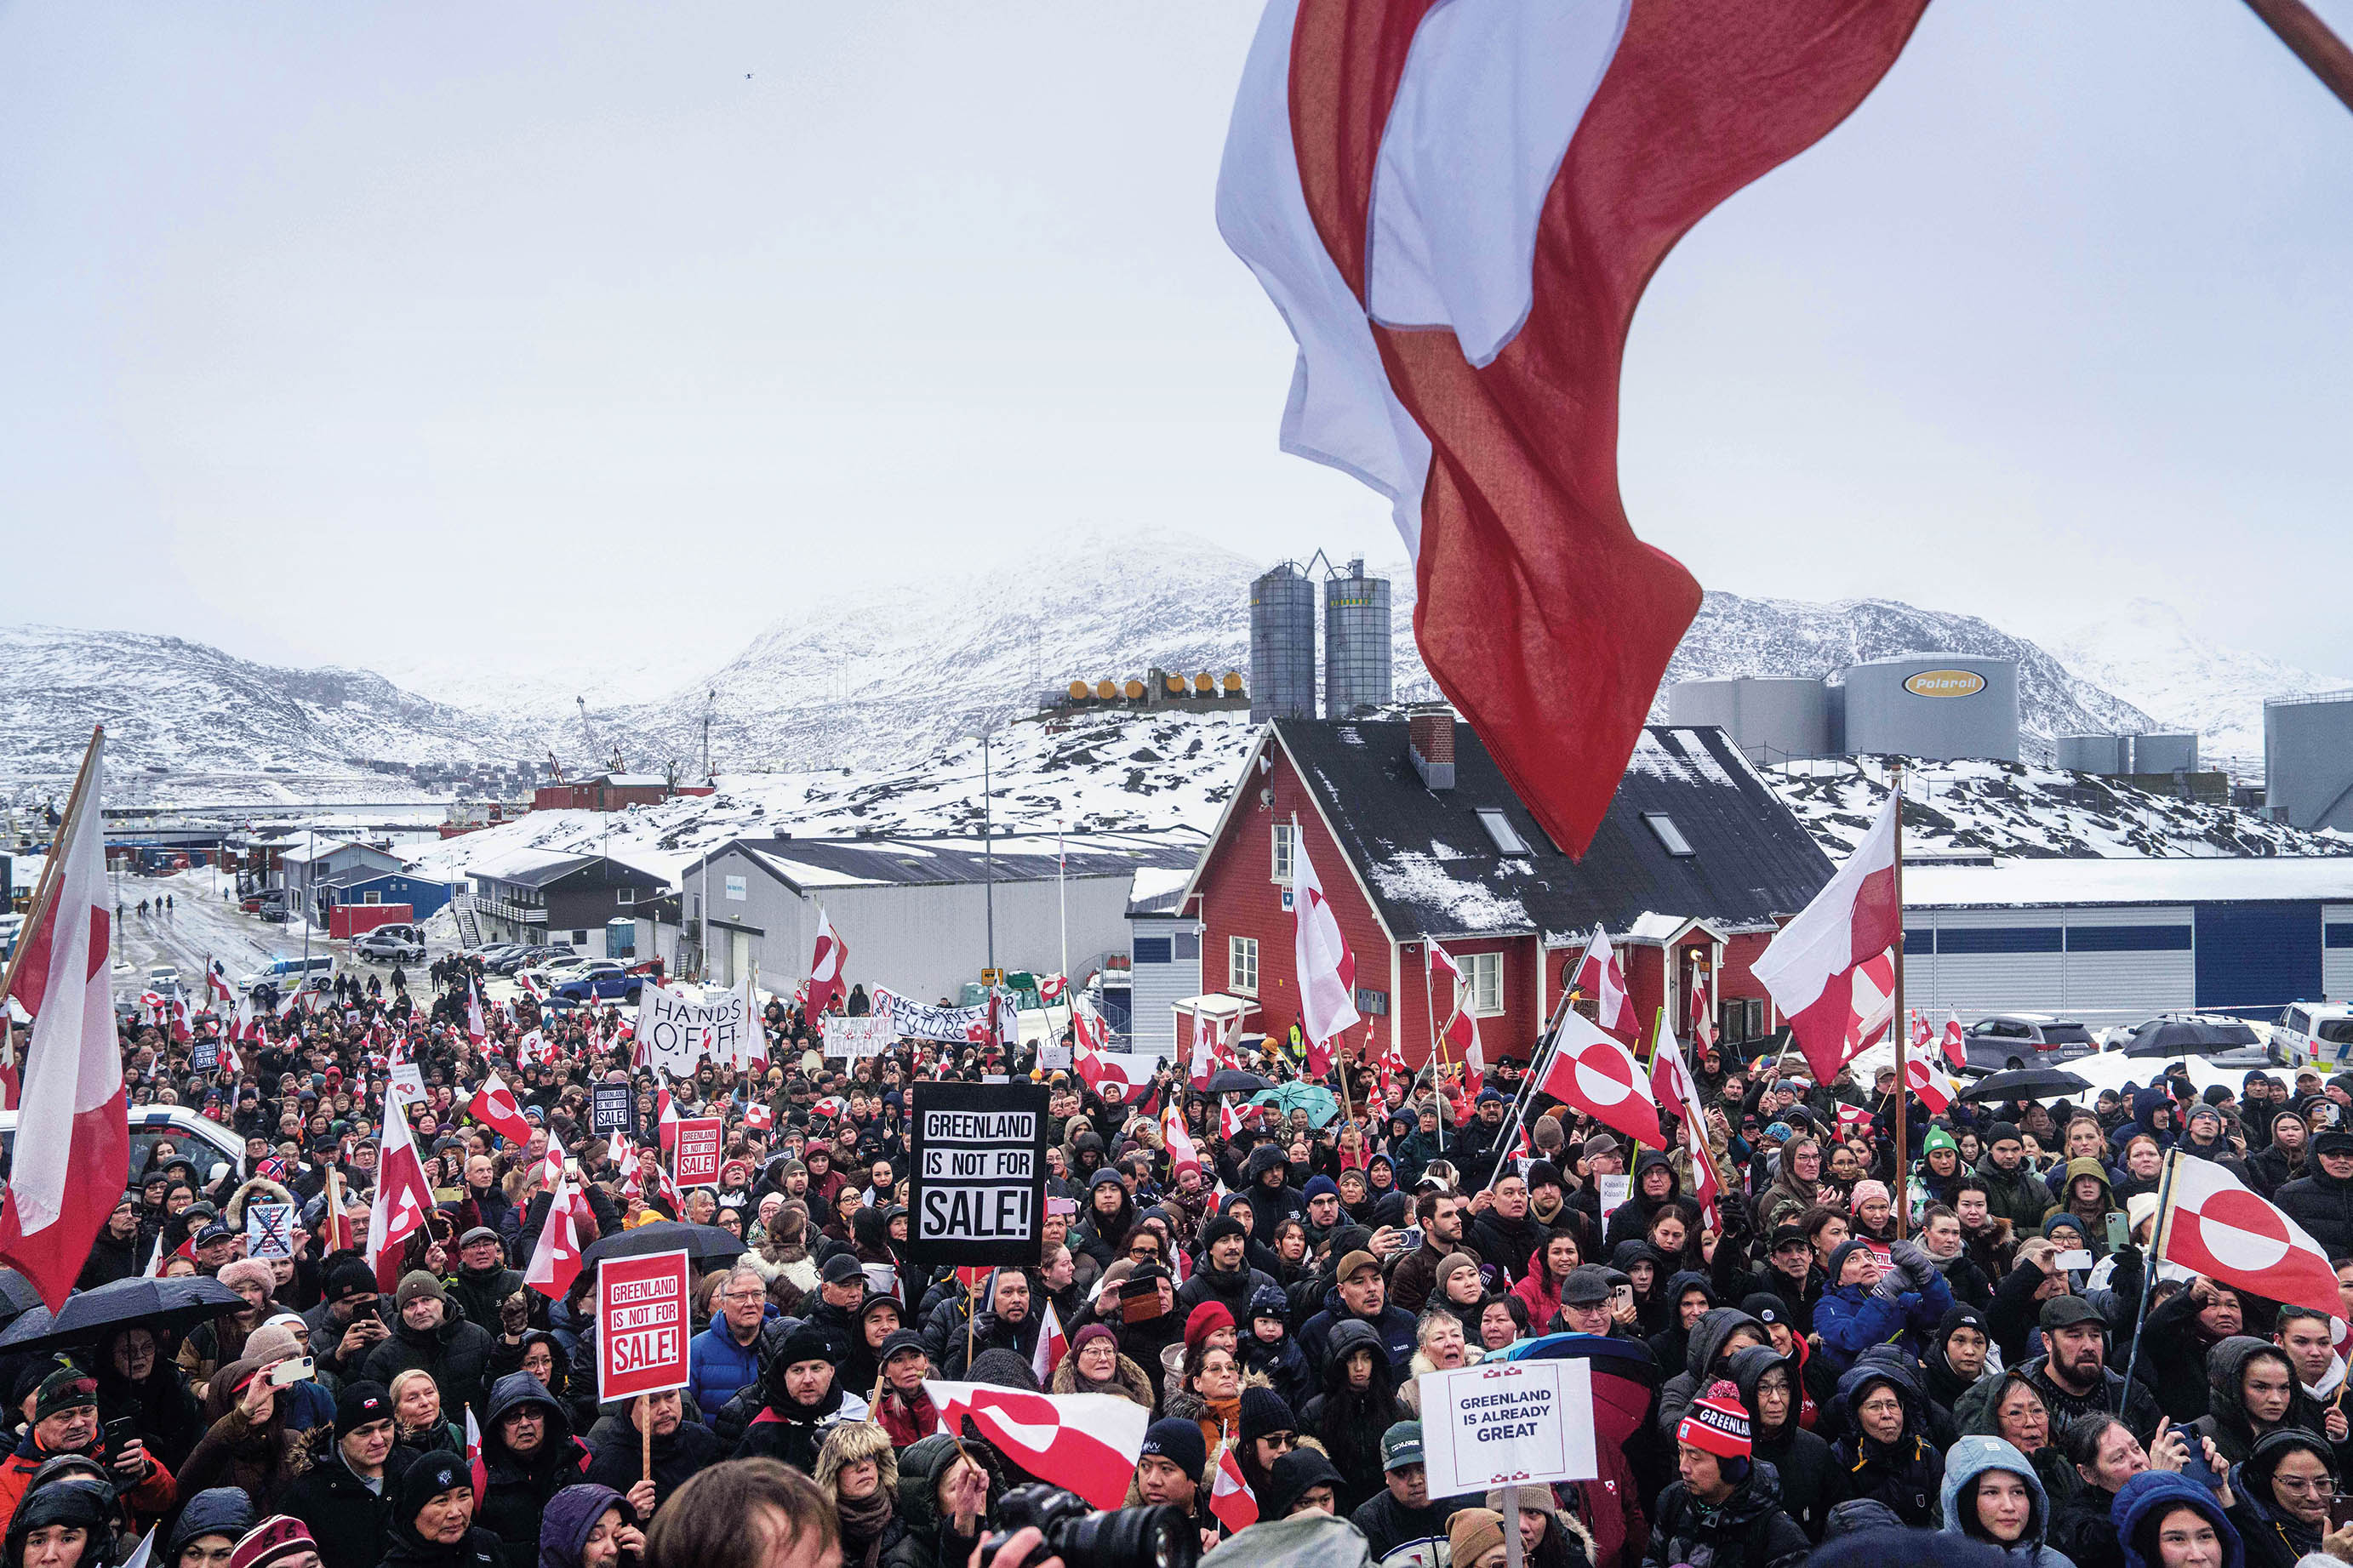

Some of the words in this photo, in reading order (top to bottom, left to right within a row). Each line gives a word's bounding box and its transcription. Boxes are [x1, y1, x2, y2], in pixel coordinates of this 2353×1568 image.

[1916, 678, 1976, 688] Polaroil
[654, 998, 741, 1023] HANDS
[894, 996, 918, 1016] WE
[831, 1019, 846, 1034] WE
[870, 1019, 890, 1035] NOT
[892, 1008, 966, 1040] FUTURE
[197, 1058, 217, 1068] SALE
[598, 1110, 626, 1125] SALE!
[928, 1114, 1032, 1138] GREENLAND
[683, 1131, 716, 1141] GREENLAND
[690, 1144, 701, 1153] NOT
[682, 1156, 715, 1174] SALE!
[926, 1152, 943, 1175] IS
[951, 1153, 987, 1176] NOT
[997, 1152, 1031, 1175] FOR
[923, 1190, 1029, 1236] SALE!
[613, 1278, 676, 1302] GREENLAND
[613, 1311, 624, 1328] IS
[629, 1307, 650, 1326] NOT
[656, 1303, 677, 1321] FOR
[614, 1329, 677, 1371] SALE!
[1460, 1389, 1551, 1409] GREENLAND
[1464, 1414, 1476, 1425] IS
[1482, 1405, 1551, 1423] ALREADY
[1476, 1423, 1538, 1442] GREAT
